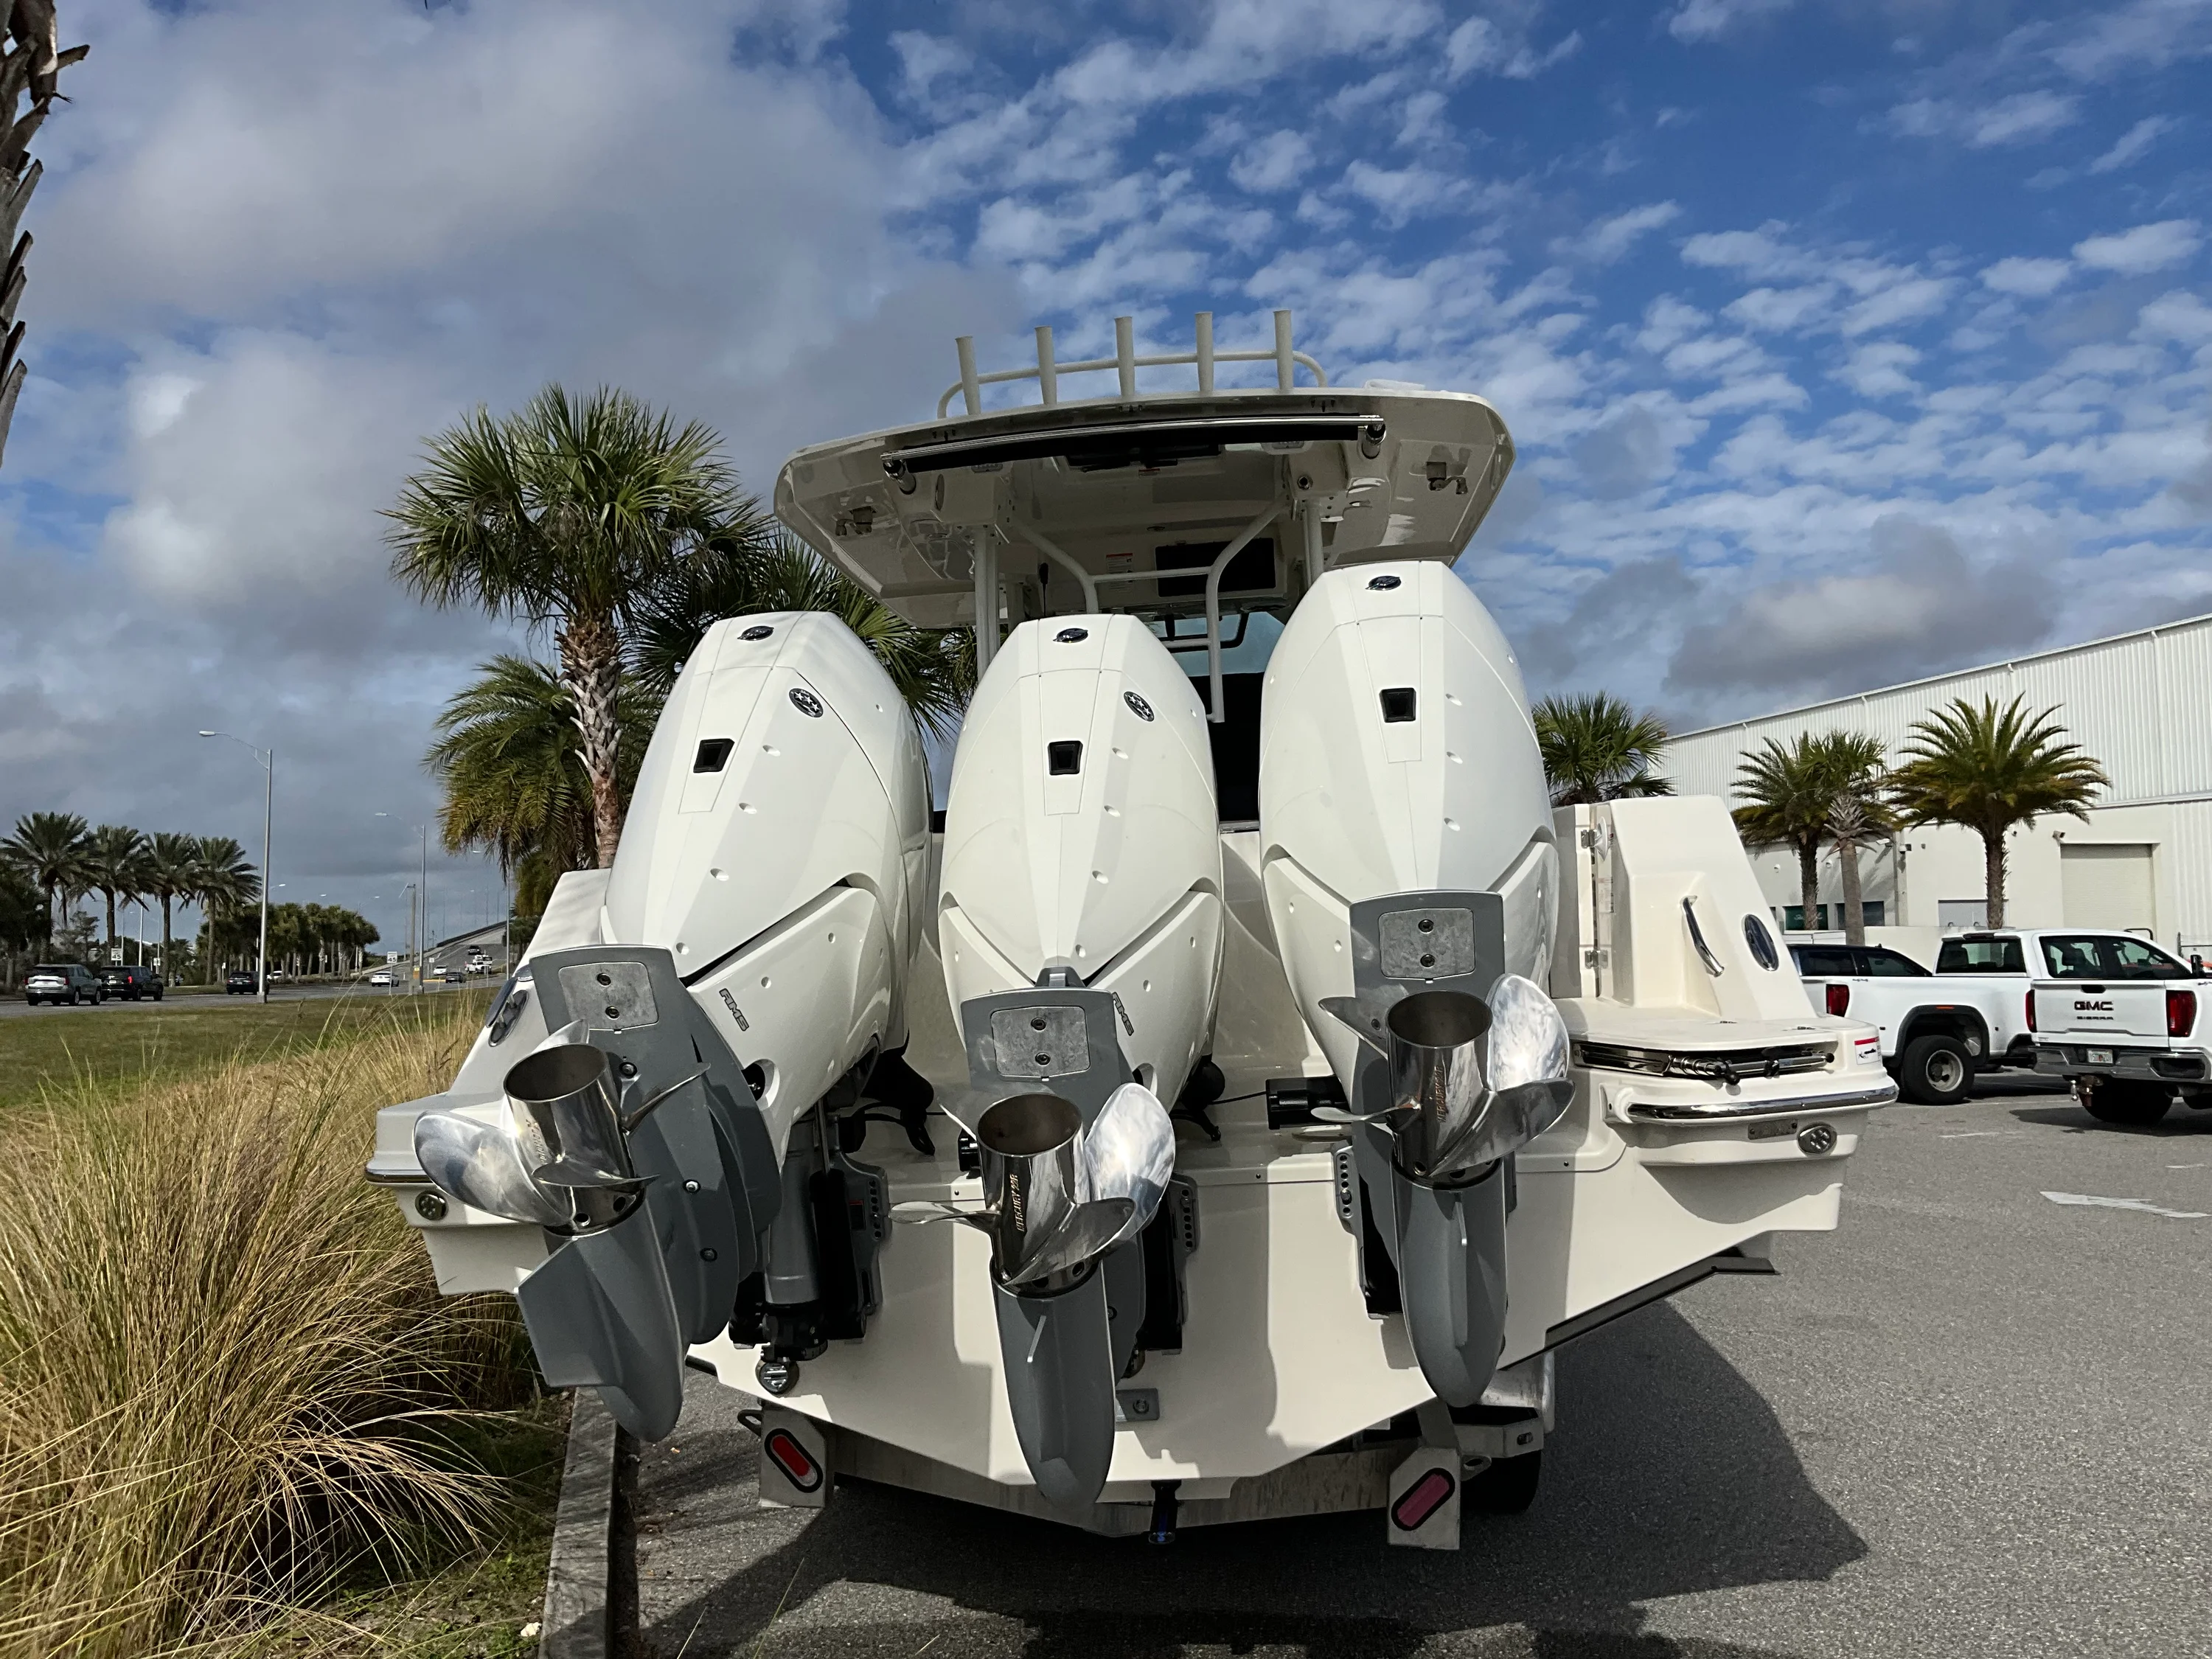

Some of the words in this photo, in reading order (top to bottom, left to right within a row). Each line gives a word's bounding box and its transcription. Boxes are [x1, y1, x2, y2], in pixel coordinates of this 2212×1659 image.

[719, 988, 749, 1032] AMS
[1112, 992, 1134, 1036] AMS
[2074, 1001, 2114, 1011] GMC
[1012, 1190, 1025, 1232] MERCURY
